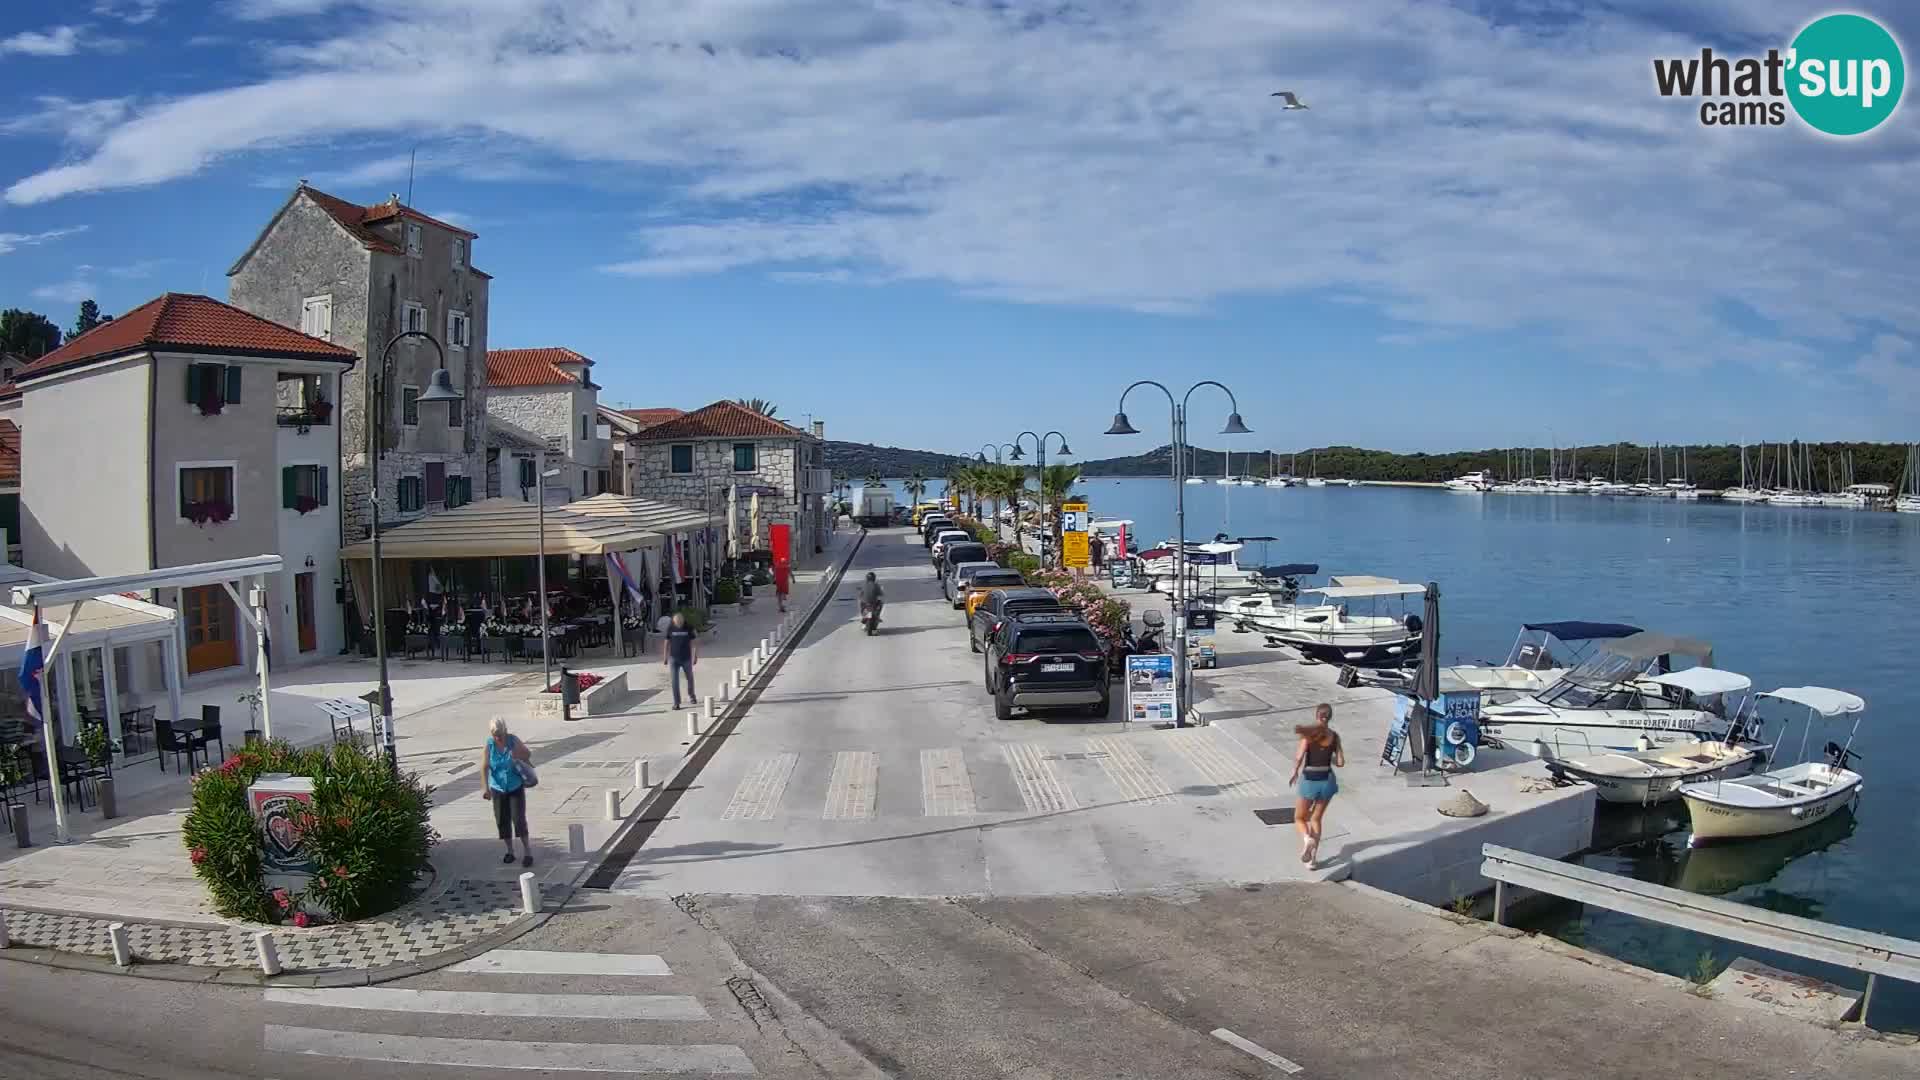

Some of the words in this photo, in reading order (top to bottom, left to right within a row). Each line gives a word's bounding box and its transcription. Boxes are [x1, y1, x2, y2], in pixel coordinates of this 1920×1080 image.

[1064, 513, 1076, 531] P
[1447, 697, 1478, 710] RENT
[1446, 710, 1454, 719] A
[1455, 709, 1478, 719] BOAT
[1652, 719, 1670, 729] RENT
[1679, 719, 1695, 730] BOAT
